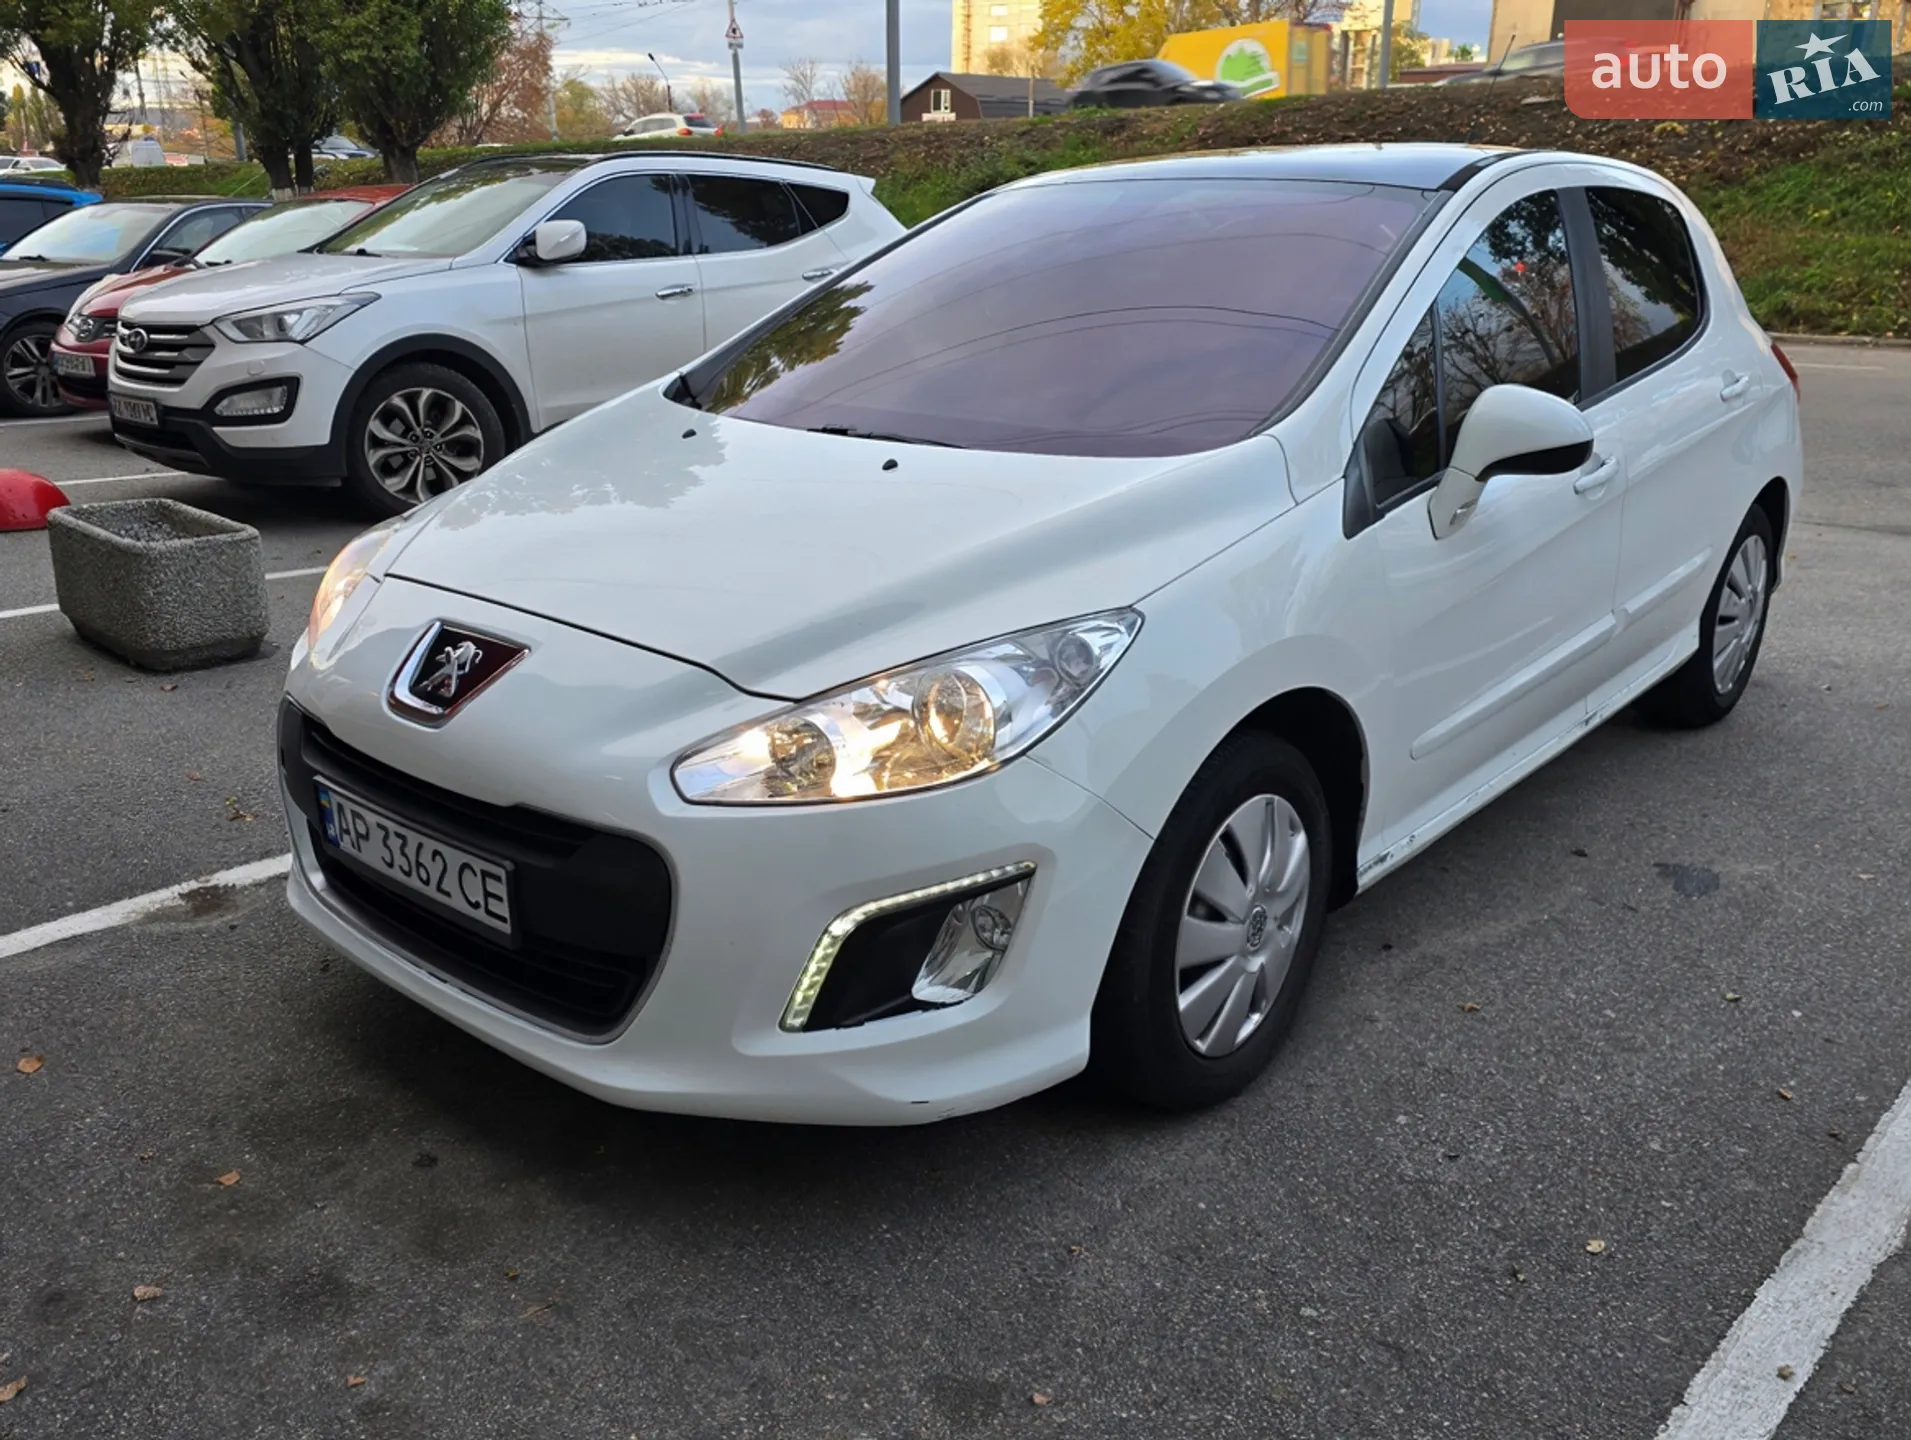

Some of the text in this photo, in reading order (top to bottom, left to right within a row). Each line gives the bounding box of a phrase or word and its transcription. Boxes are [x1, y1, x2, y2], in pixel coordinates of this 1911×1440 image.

[337, 802, 508, 924] AP 3362 CE
